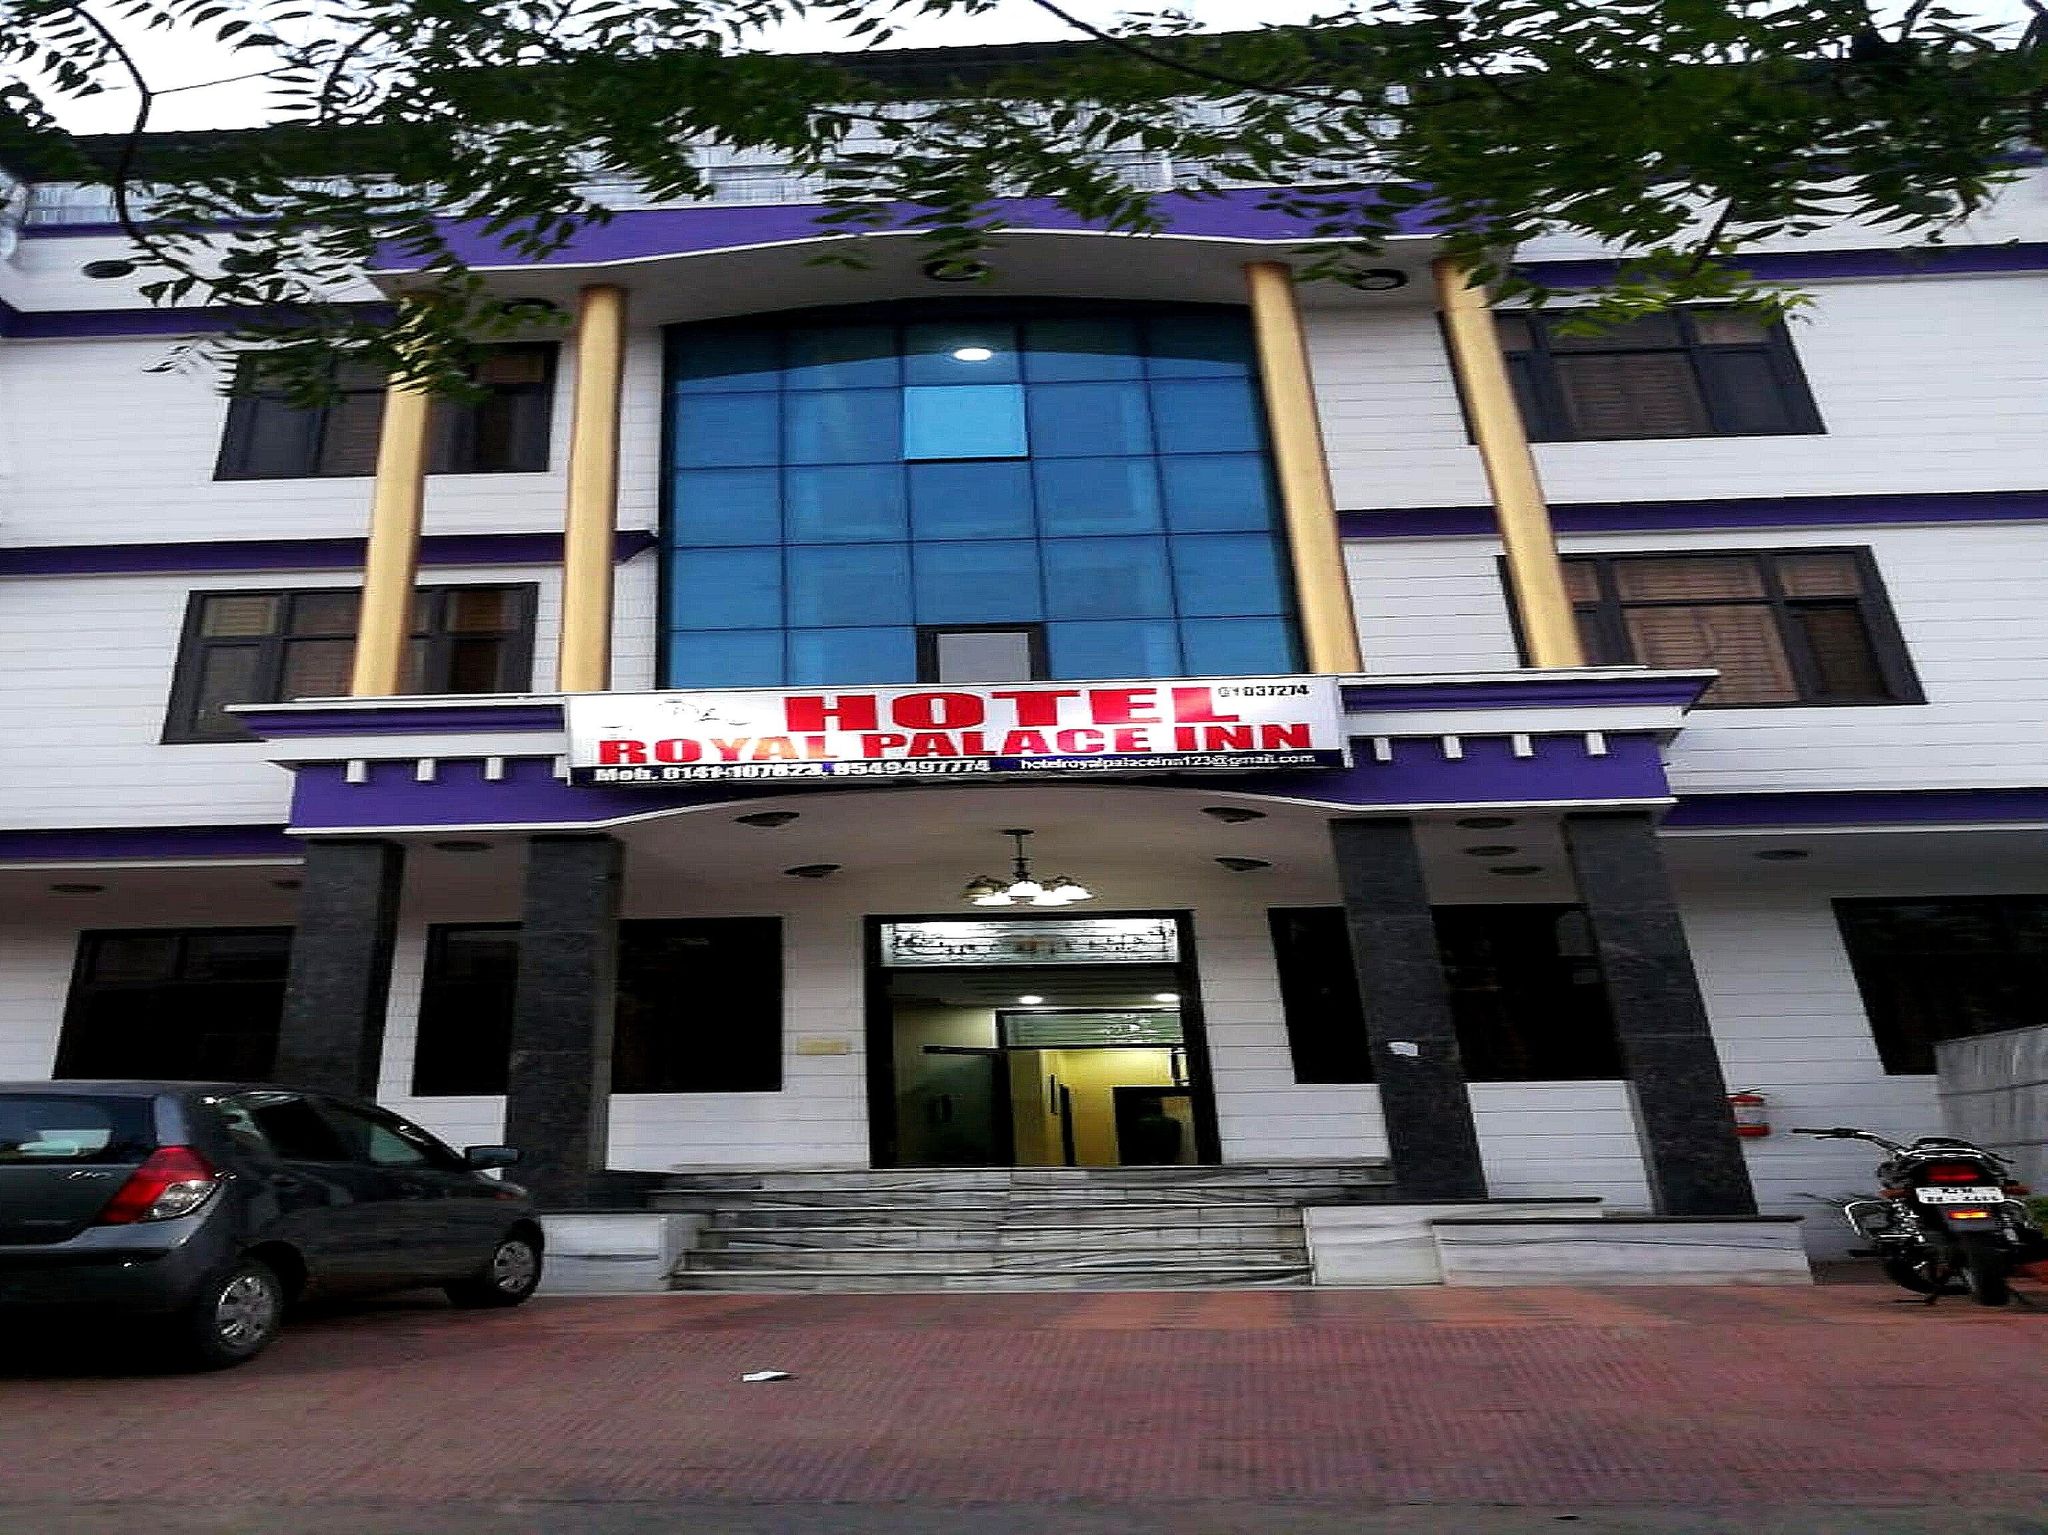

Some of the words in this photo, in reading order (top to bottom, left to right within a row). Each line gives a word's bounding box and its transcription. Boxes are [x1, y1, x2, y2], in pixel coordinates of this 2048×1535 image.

[785, 687, 1239, 731] HOTEL
[600, 734, 839, 765] ROYAL
[861, 728, 1153, 759] PALACE
[1175, 724, 1313, 752] INN
